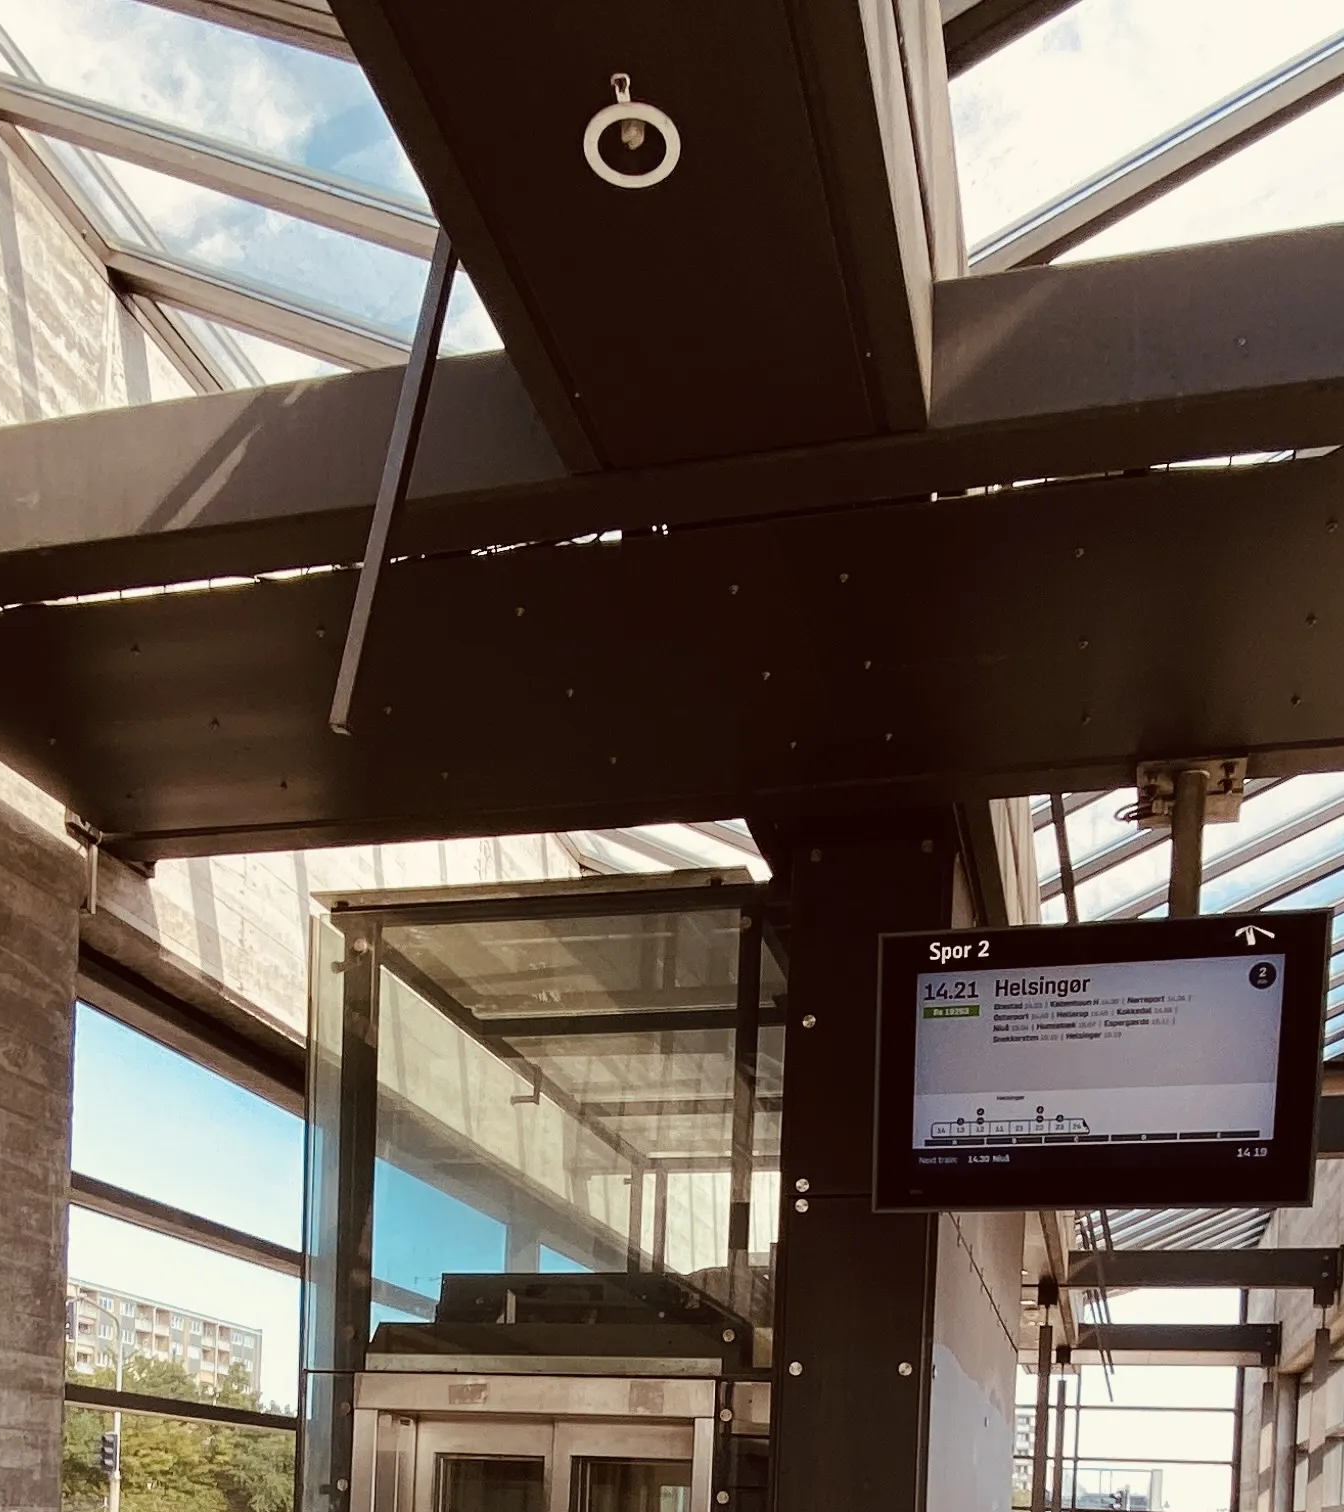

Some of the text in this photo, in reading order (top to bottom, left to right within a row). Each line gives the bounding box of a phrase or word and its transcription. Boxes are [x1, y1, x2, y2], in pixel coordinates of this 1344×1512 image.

[929, 940, 990, 964] Spor 2
[1259, 967, 1267, 977] 2
[924, 976, 1091, 1000] 14.21 Helsingør
